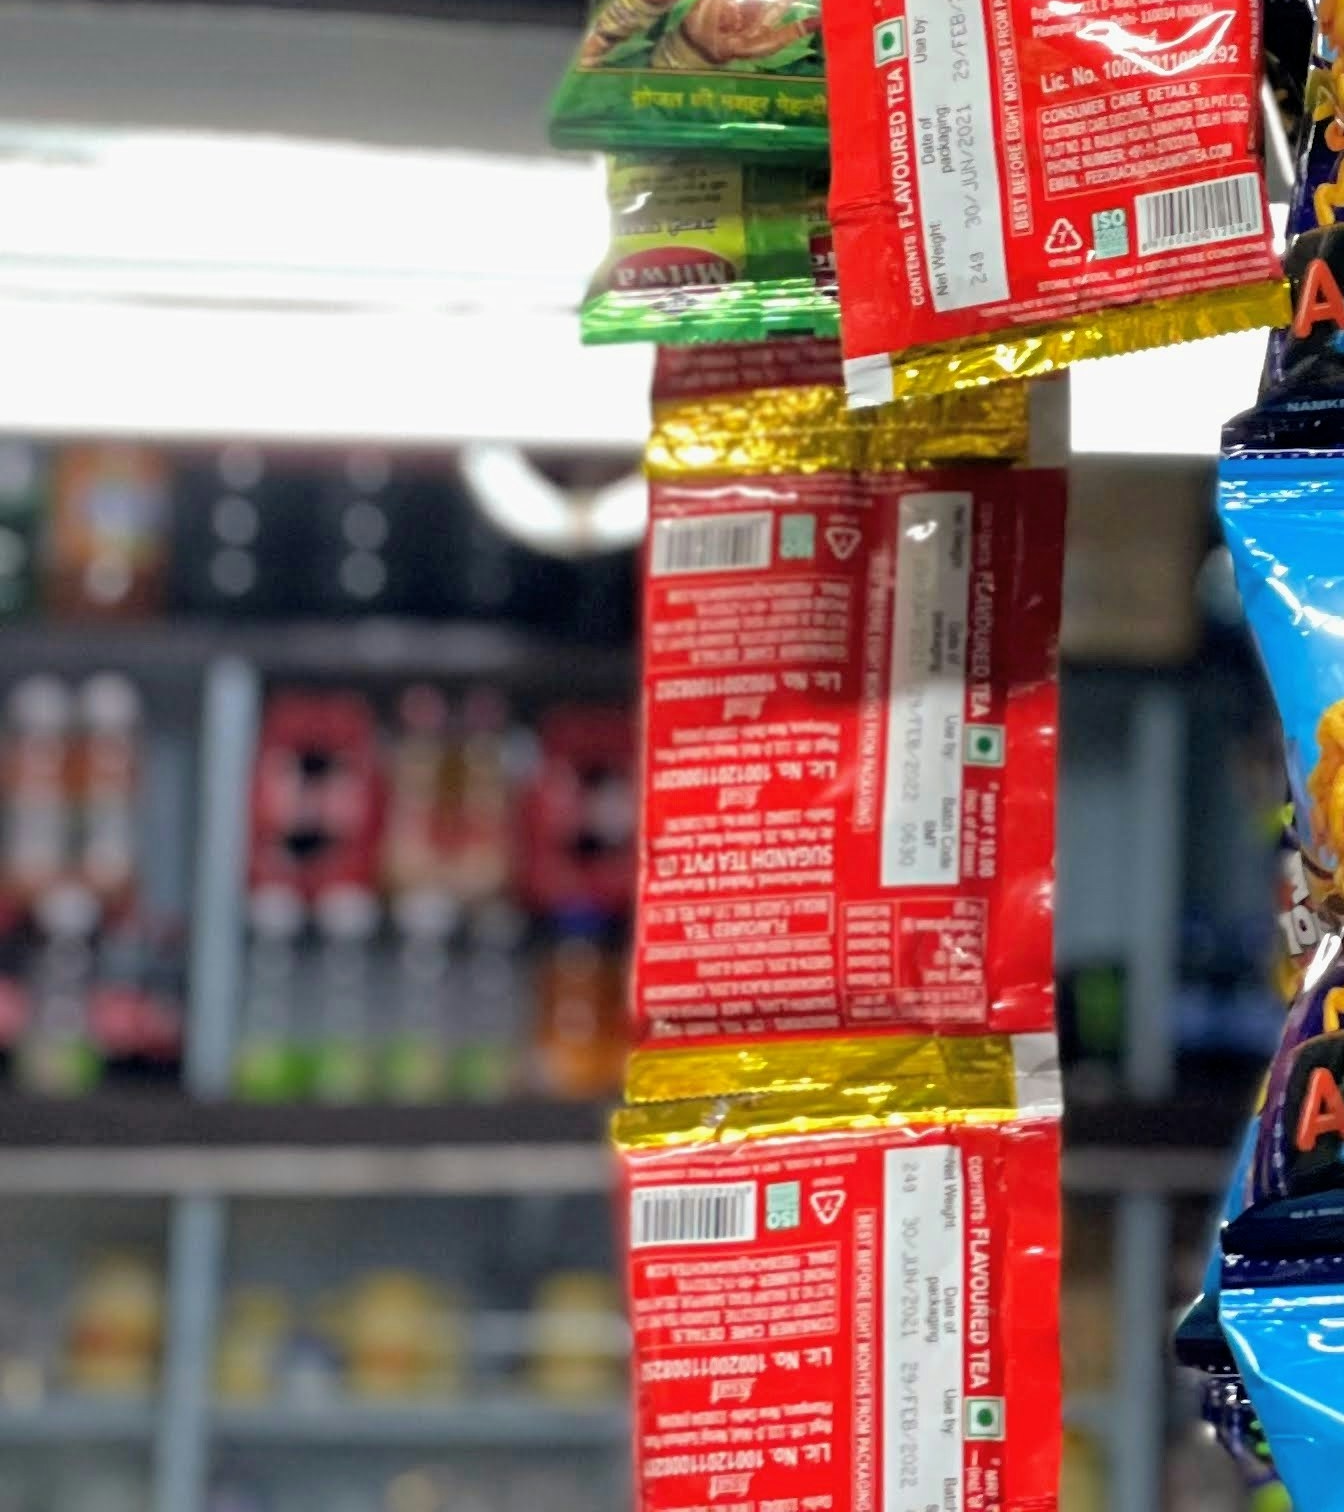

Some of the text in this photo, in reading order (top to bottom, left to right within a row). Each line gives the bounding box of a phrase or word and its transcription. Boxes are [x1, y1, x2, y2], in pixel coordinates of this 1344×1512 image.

[995, 9, 1012, 47] FROM
[914, 38, 929, 65] Use
[999, 48, 1019, 102] MONTHS
[1040, 66, 1099, 93] Lic. No.
[1109, 91, 1142, 109] CARE
[1003, 104, 1021, 141] EIGHT
[887, 67, 916, 229] FLAVOURED TEA
[919, 133, 937, 165] Date
[1007, 145, 1026, 195] BEFORE
[1013, 198, 1030, 231] BEST
[934, 272, 949, 297] Net
[970, 681, 991, 717] TEA
[941, 796, 956, 833] Batch
[854, 1213, 872, 1434] BEST BEFORE EIGHT MONTHS FROM
[942, 1285, 960, 1335] Date of
[968, 1228, 991, 1388] FLAVOURED TEA
[943, 1388, 959, 1417] Use
